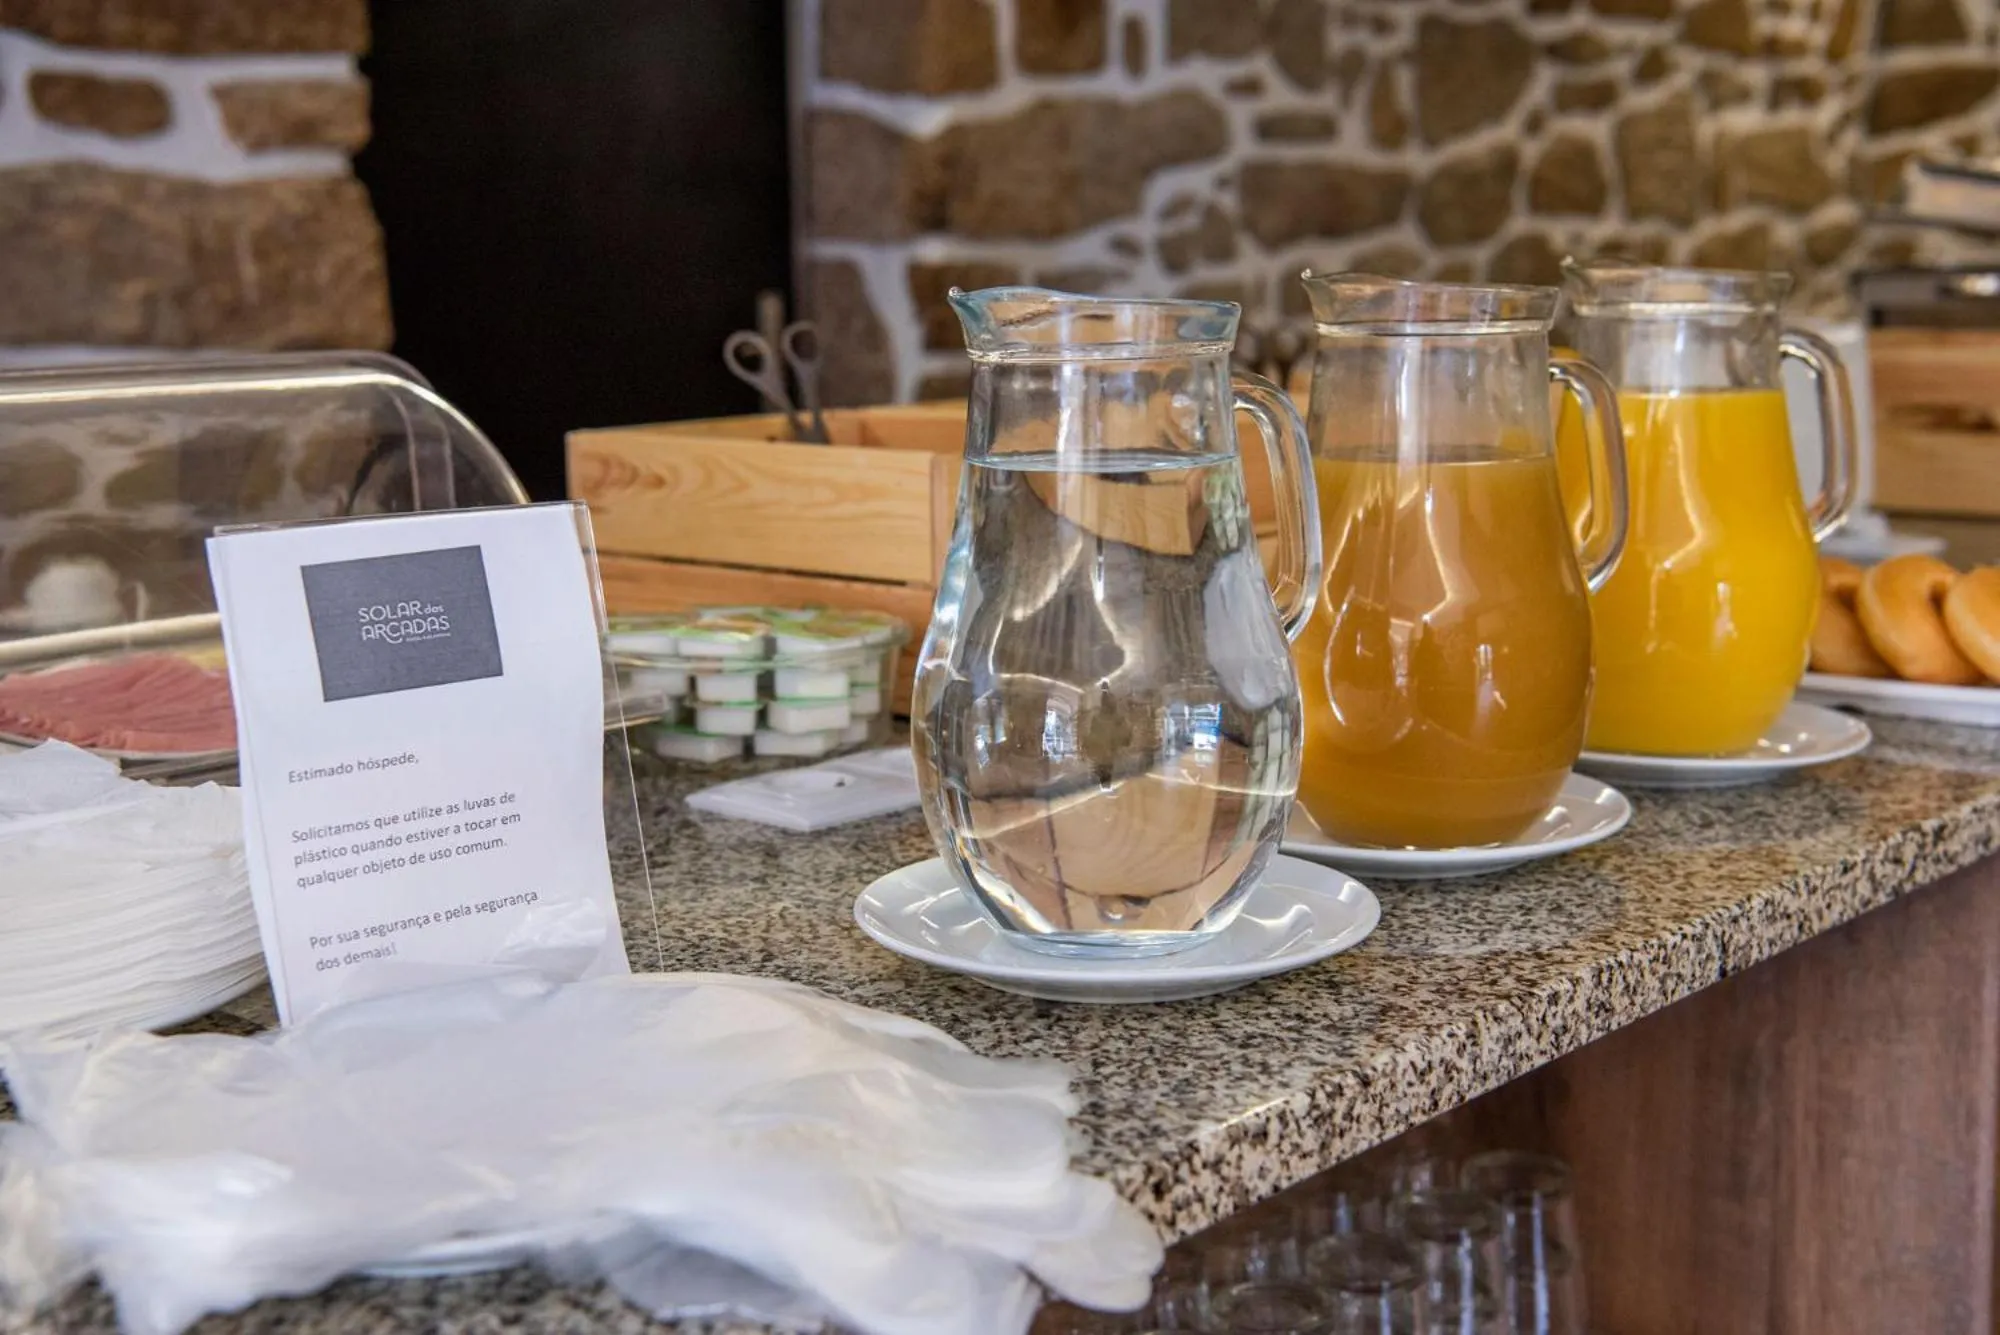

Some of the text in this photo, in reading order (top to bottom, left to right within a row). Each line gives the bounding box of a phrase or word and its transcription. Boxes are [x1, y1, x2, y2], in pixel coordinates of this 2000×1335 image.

[358, 600, 423, 622] SOLAR
[362, 616, 450, 644] ARCADAS
[288, 752, 420, 783] Estimado hóspede,
[292, 792, 516, 843] Solicitamos que utilize as luvas de
[294, 812, 521, 868] plástico quando estiver a tocar em
[296, 837, 508, 888] qualquer objeto de uso comum.
[309, 890, 538, 950] Por sua segurança e pela segurança
[316, 942, 398, 972] dos demais!
